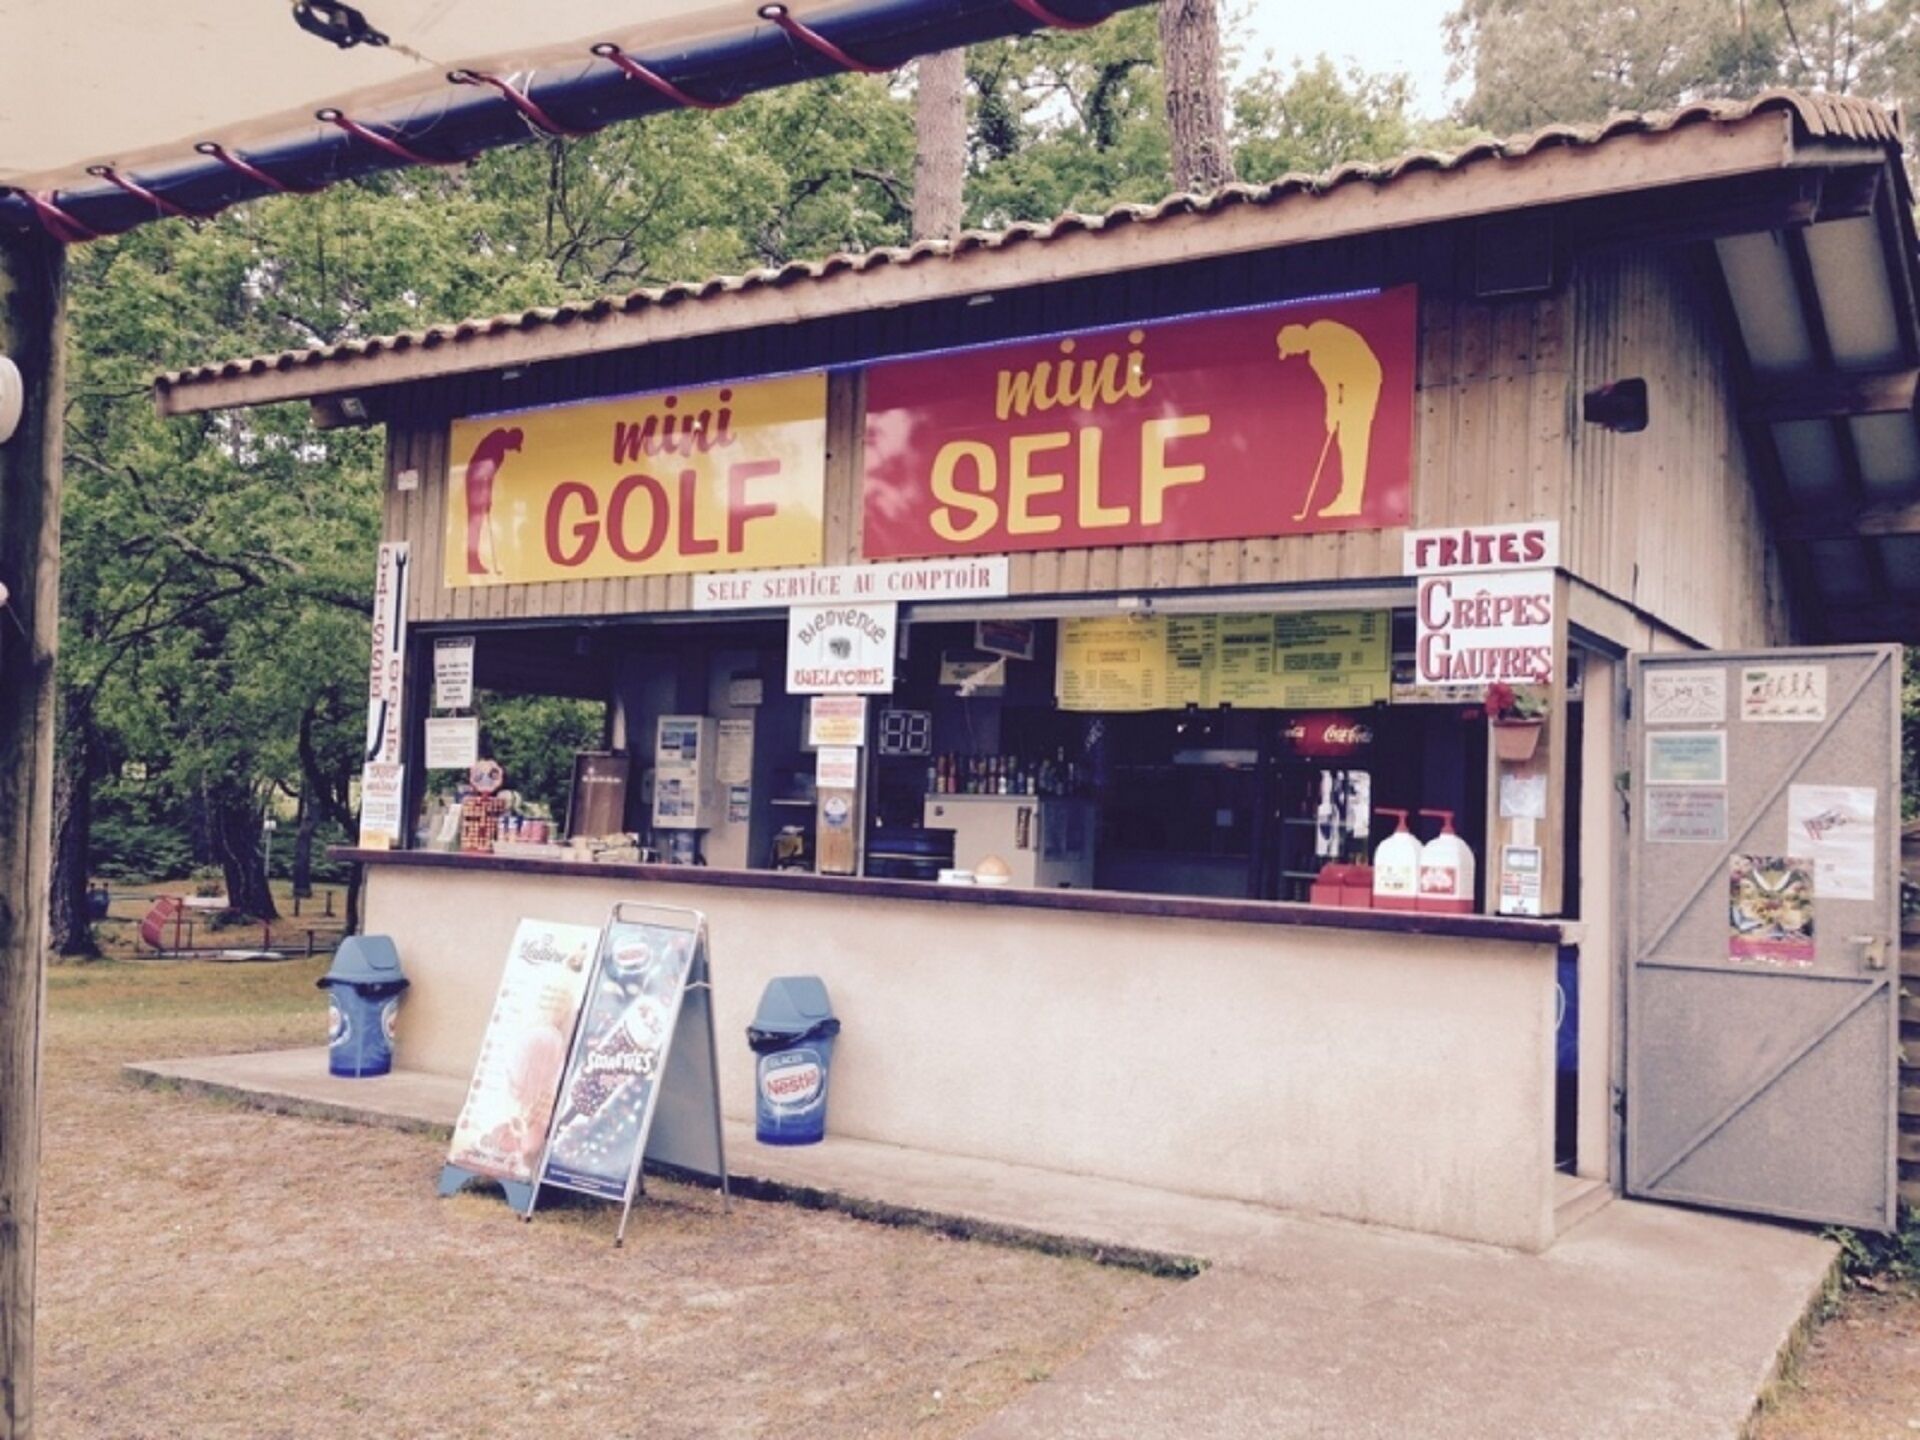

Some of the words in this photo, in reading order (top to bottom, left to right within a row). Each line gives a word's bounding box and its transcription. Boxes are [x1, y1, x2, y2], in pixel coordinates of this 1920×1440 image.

[996, 329, 1152, 420] mini
[613, 388, 736, 464] mini
[545, 459, 780, 566] GOLF
[929, 415, 1211, 542] SELF
[1415, 530, 1545, 568] FRITES
[707, 580, 751, 600] SELF
[854, 575, 875, 594] AU
[794, 667, 884, 685] WELCOME
